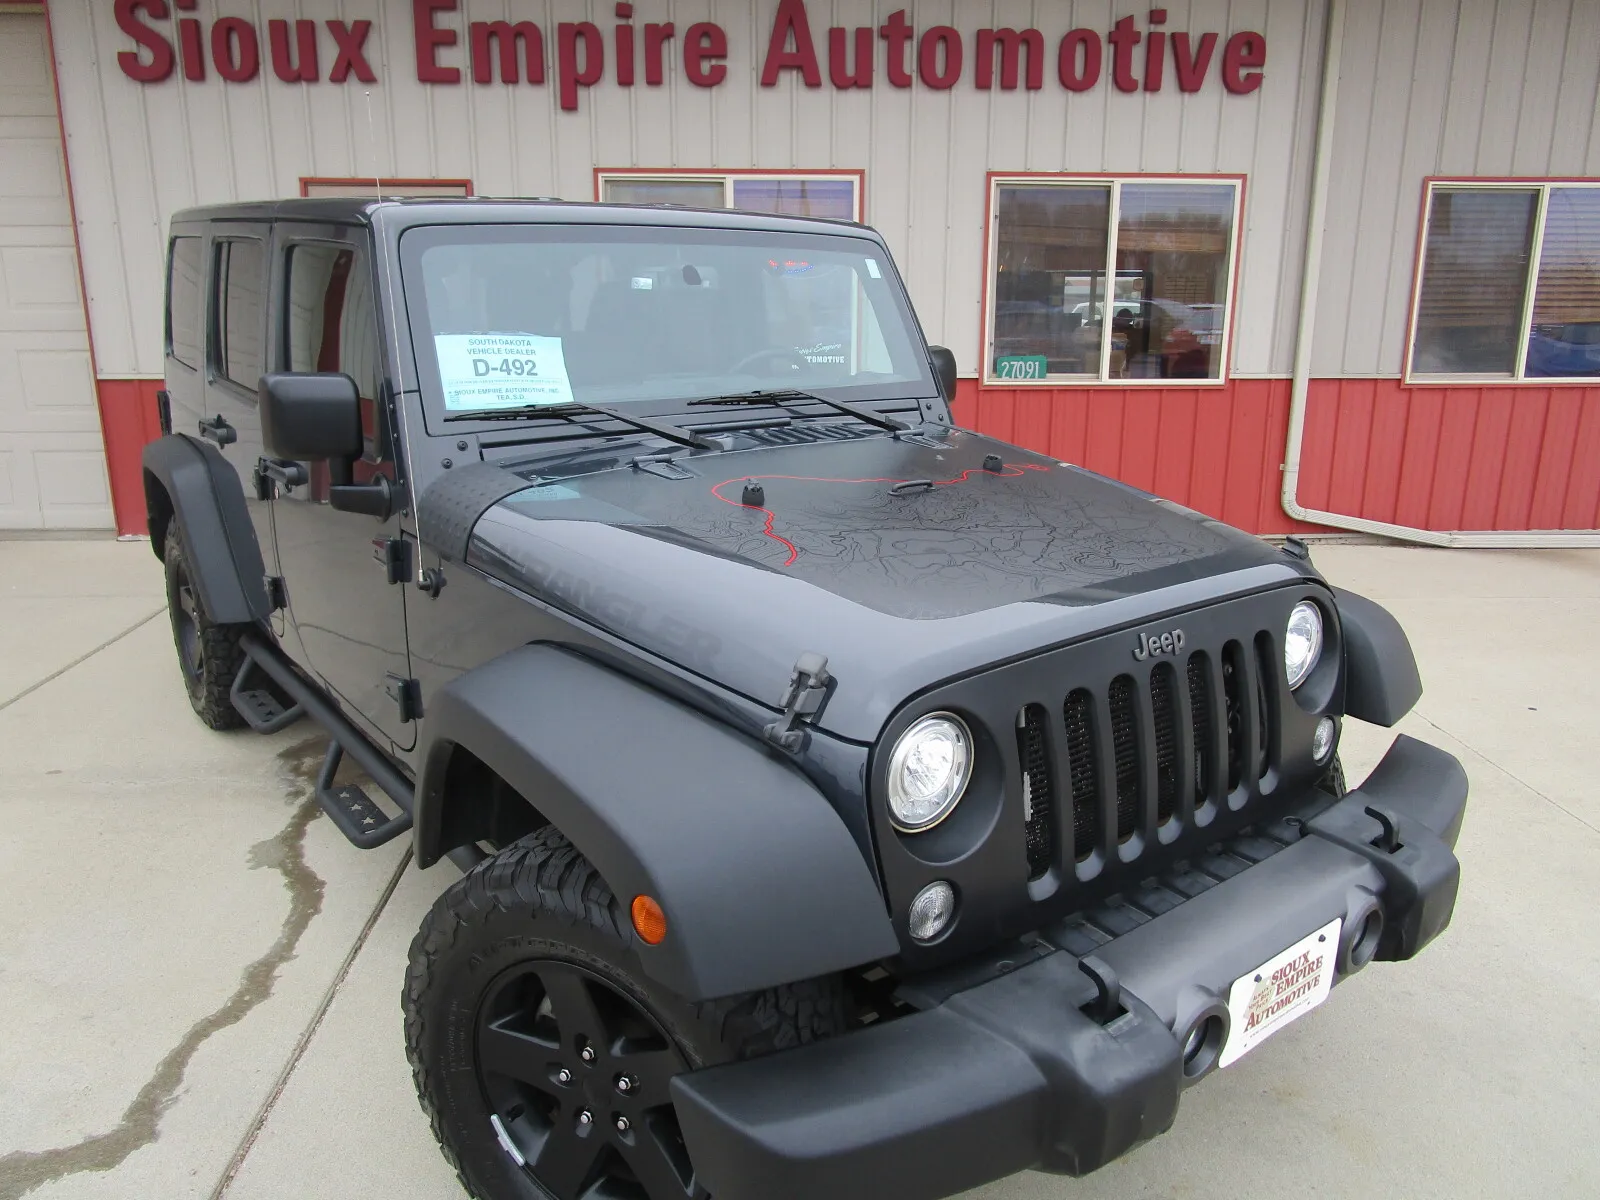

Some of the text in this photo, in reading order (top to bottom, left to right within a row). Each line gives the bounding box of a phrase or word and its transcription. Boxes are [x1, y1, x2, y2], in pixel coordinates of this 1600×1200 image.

[114, 0, 1267, 111] Sioux Empire Automotive
[467, 347, 537, 356] VEHICLE DEALER
[468, 338, 532, 347] SOUTH DAKOTA
[472, 358, 539, 377] D-492
[805, 355, 845, 364] TOMOTIVE
[1001, 361, 1040, 379] 27091
[477, 387, 504, 395] EMPIRE
[1132, 628, 1185, 661] Jeep
[1271, 950, 1311, 986] SIOUX
[1275, 955, 1324, 997] EMPIRE
[1243, 974, 1321, 1033] AUTOMOTIVE
